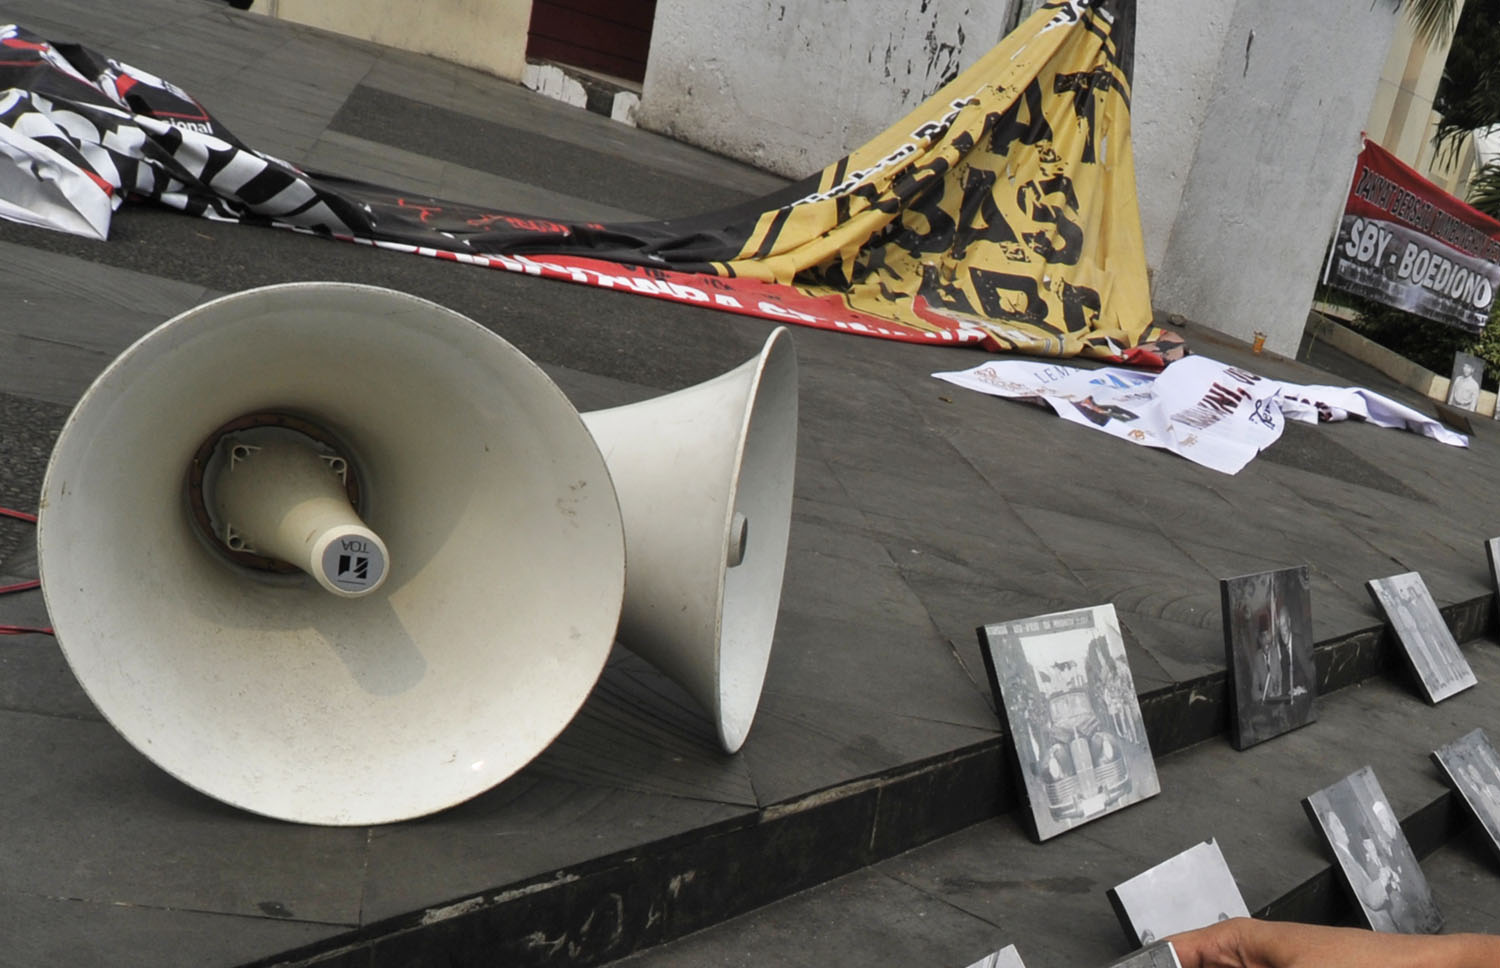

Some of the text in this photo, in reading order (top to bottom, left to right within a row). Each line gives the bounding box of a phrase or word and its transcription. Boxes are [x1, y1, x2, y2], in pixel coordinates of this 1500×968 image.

[1345, 218, 1392, 267] SBY
[1398, 242, 1493, 308] BOEDIONO
[341, 539, 369, 553] TOA
